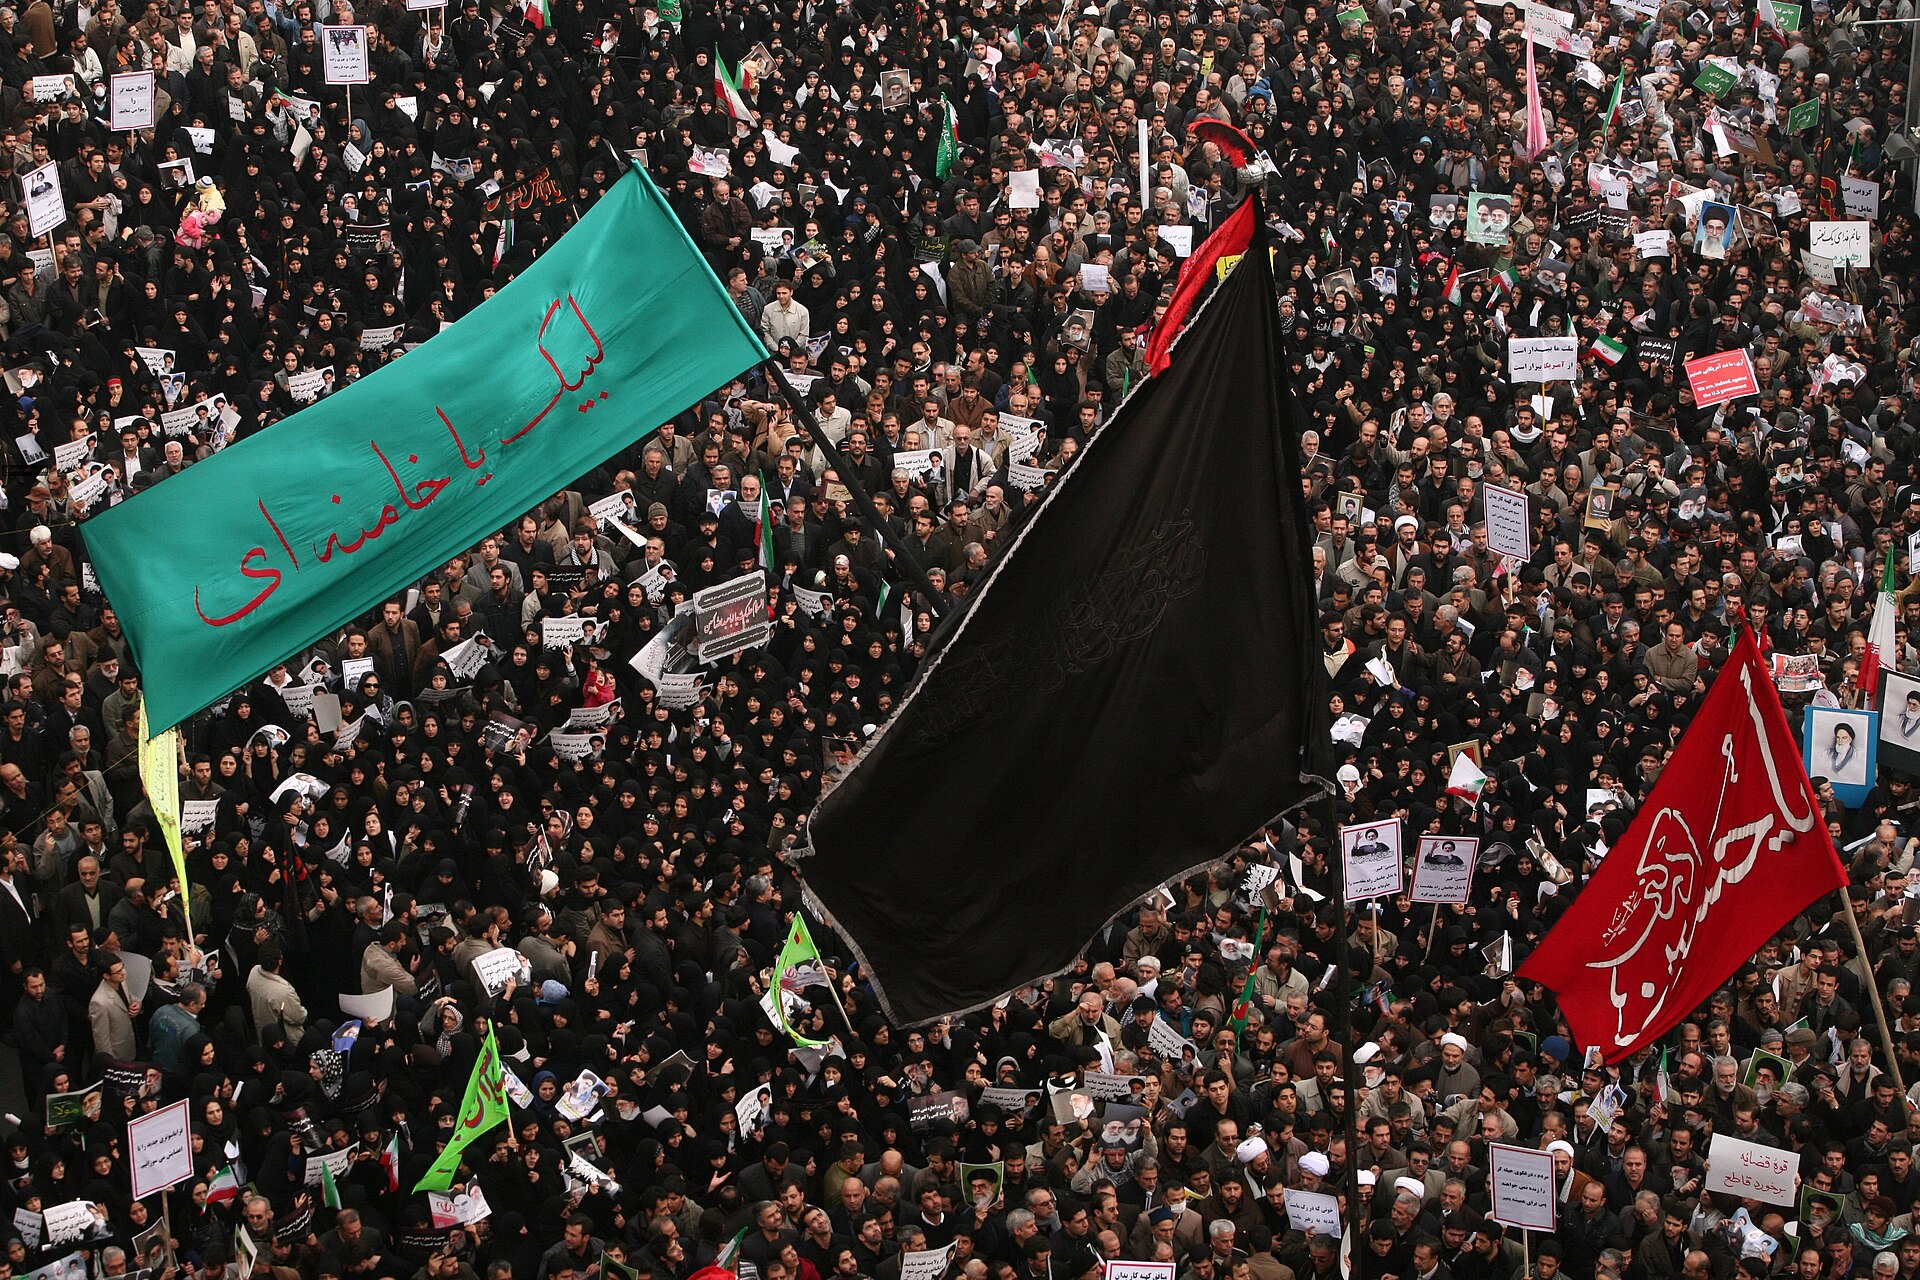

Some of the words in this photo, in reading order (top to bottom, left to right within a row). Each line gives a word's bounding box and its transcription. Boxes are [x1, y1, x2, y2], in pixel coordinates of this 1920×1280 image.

[500, 292, 609, 445] لبیک
[1544, 361, 1564, 370] آمریکا
[435, 406, 494, 487] یا
[313, 440, 450, 563] خامنه
[194, 498, 300, 628] ای
[1754, 1179, 1786, 1198] برخورد
